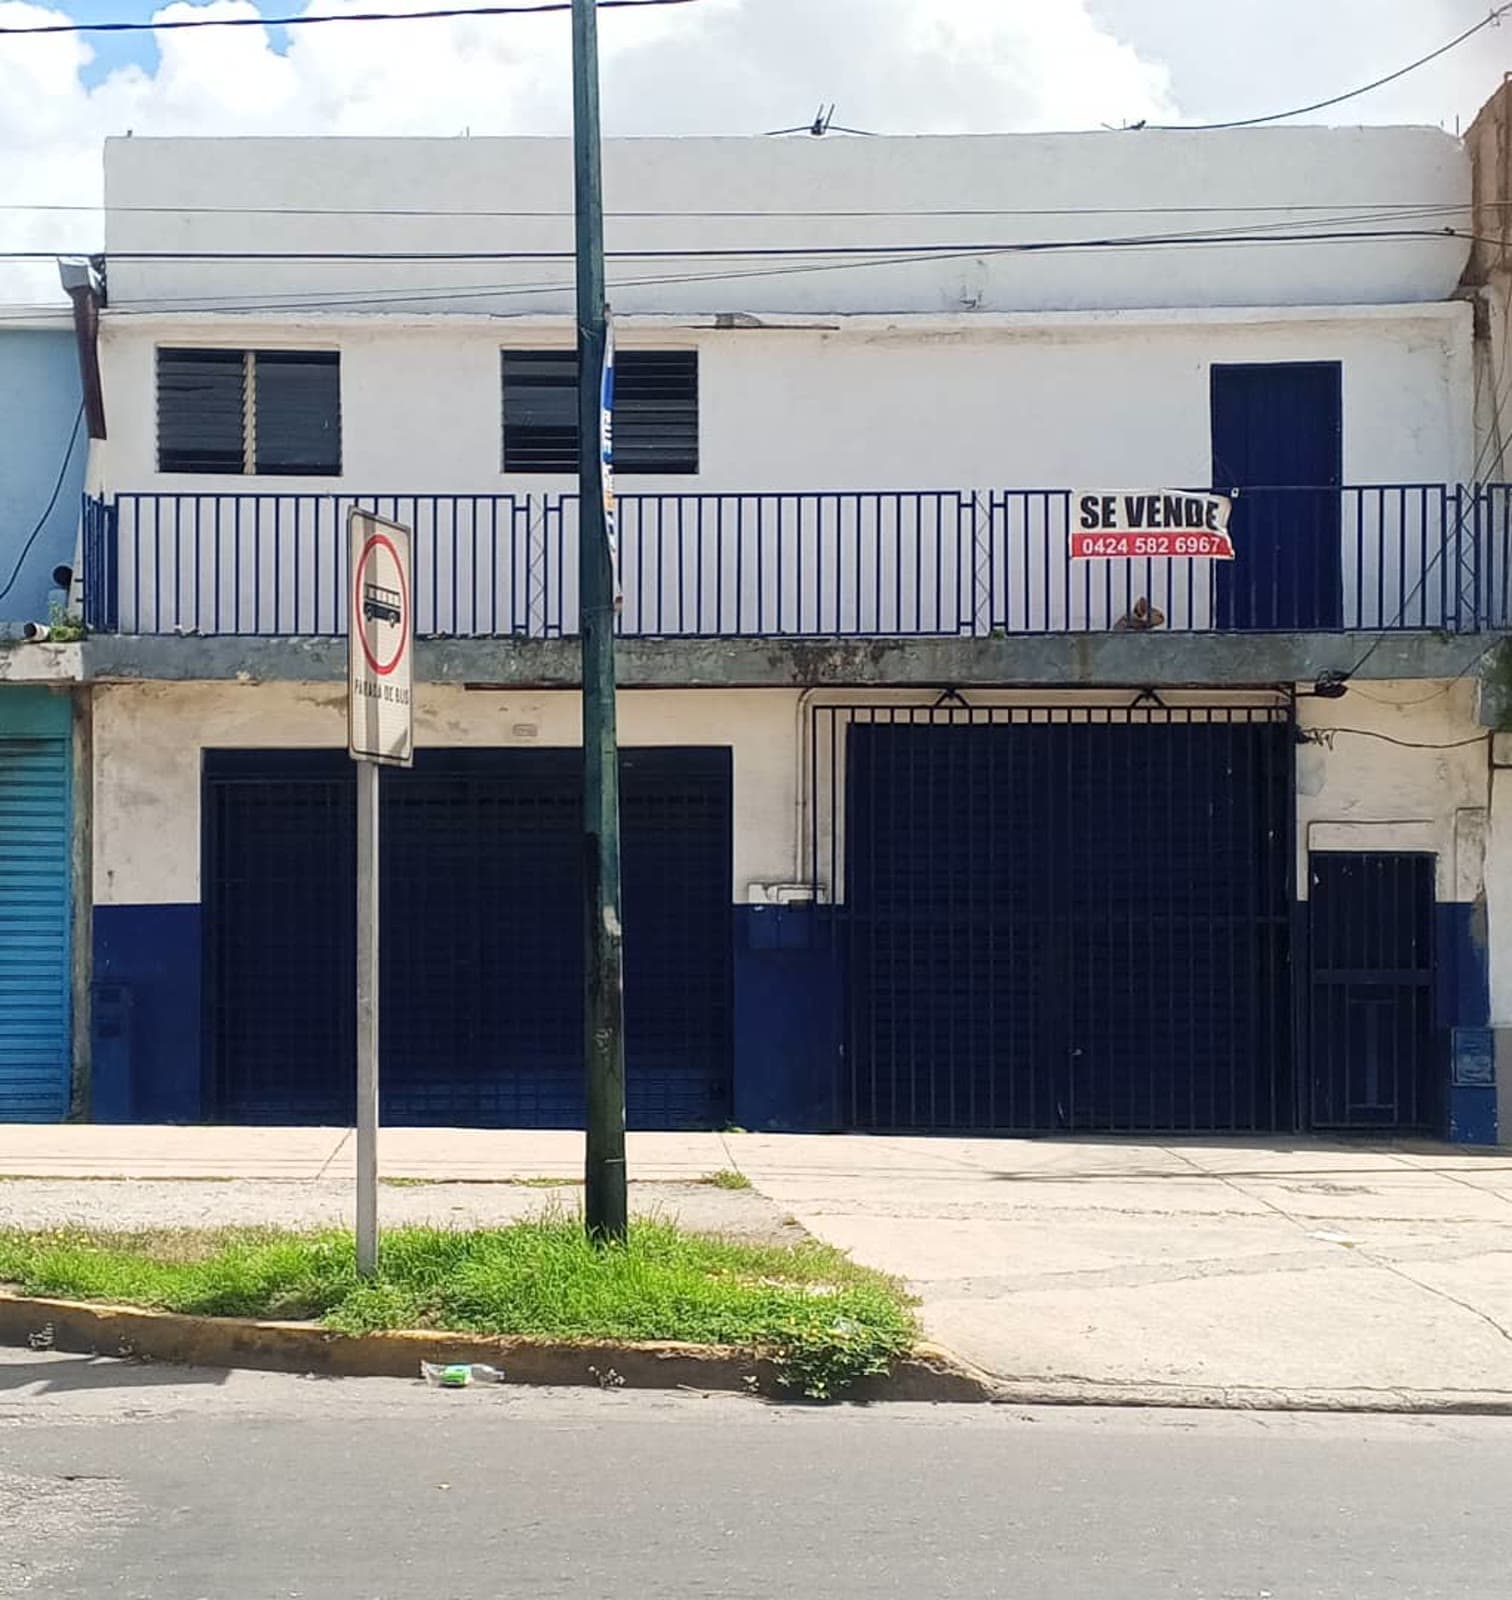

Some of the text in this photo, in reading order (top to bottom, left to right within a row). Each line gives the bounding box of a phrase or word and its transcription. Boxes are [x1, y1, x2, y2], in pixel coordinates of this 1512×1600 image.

[1080, 495, 1219, 530] SE VENDE
[1082, 536, 1220, 554] 0424 582 6967
[384, 684, 393, 702] DE
[395, 687, 409, 704] BUS
